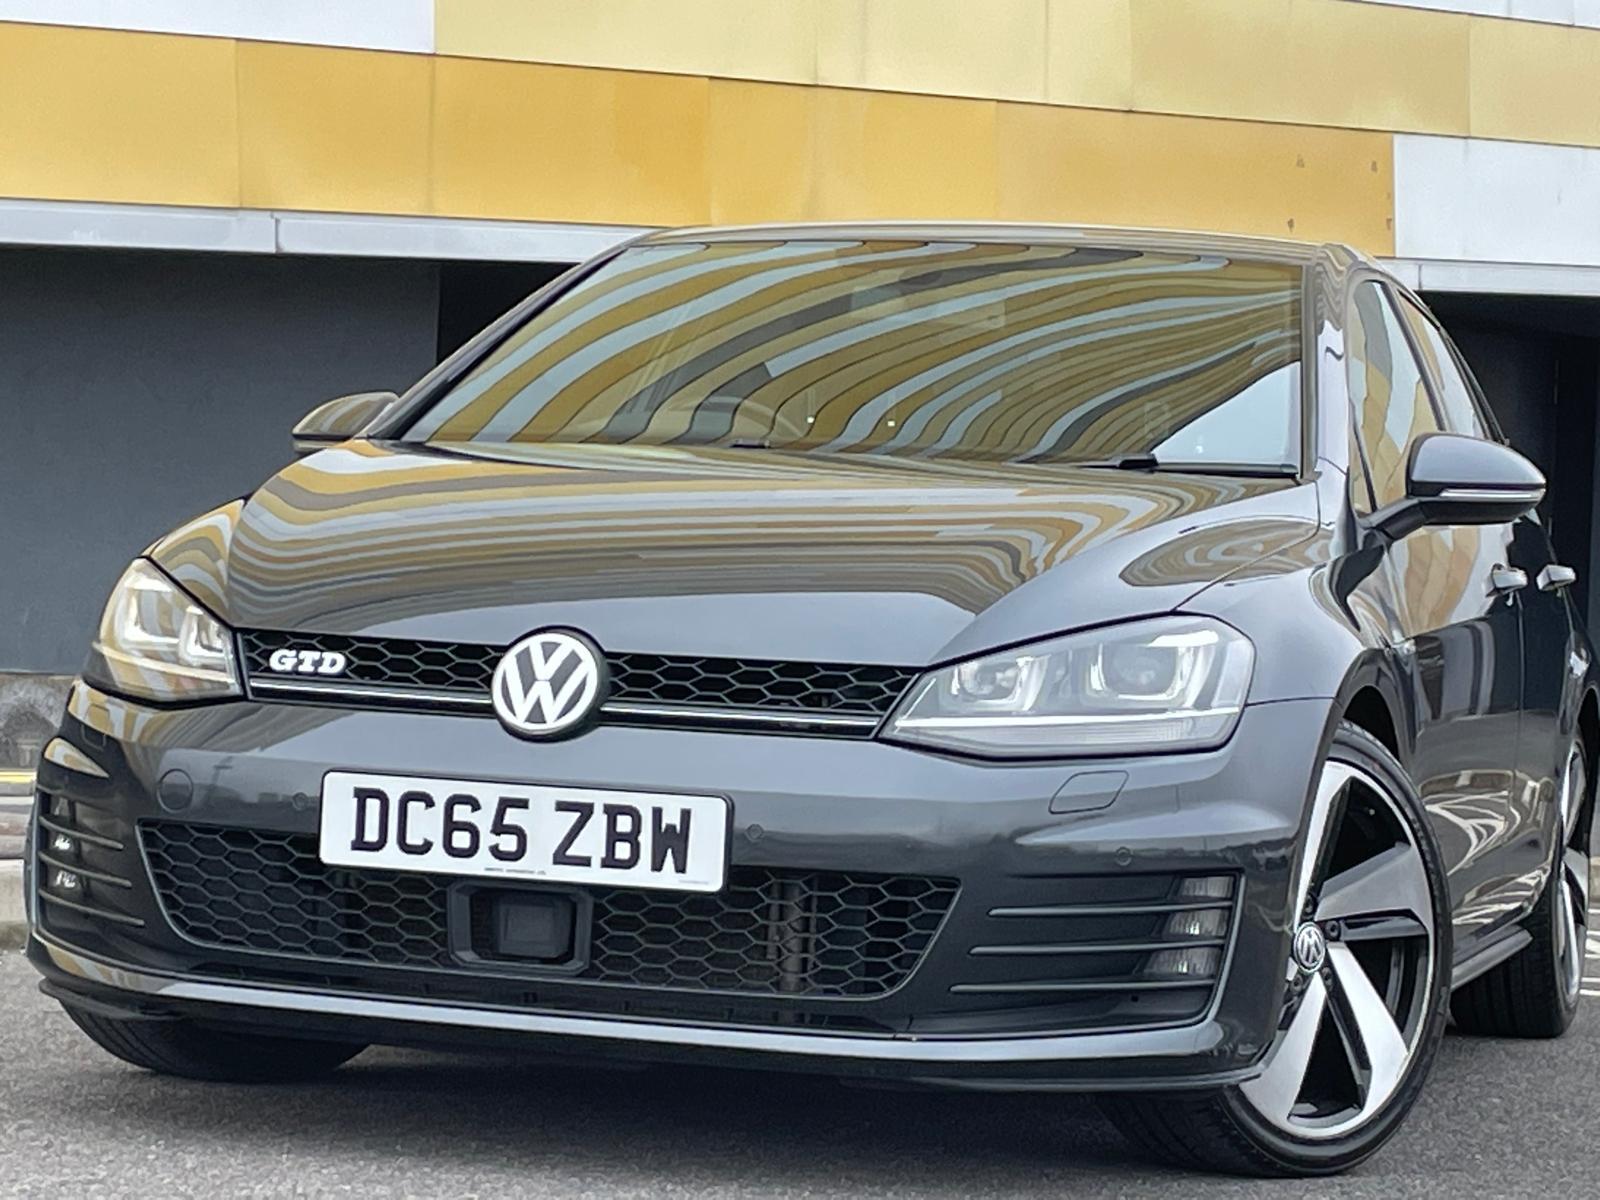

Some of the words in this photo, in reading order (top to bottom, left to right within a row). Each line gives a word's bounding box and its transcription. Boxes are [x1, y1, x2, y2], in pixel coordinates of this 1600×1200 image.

[268, 648, 347, 675] GTD
[350, 786, 530, 862] DC65
[551, 799, 692, 874] ZBW
